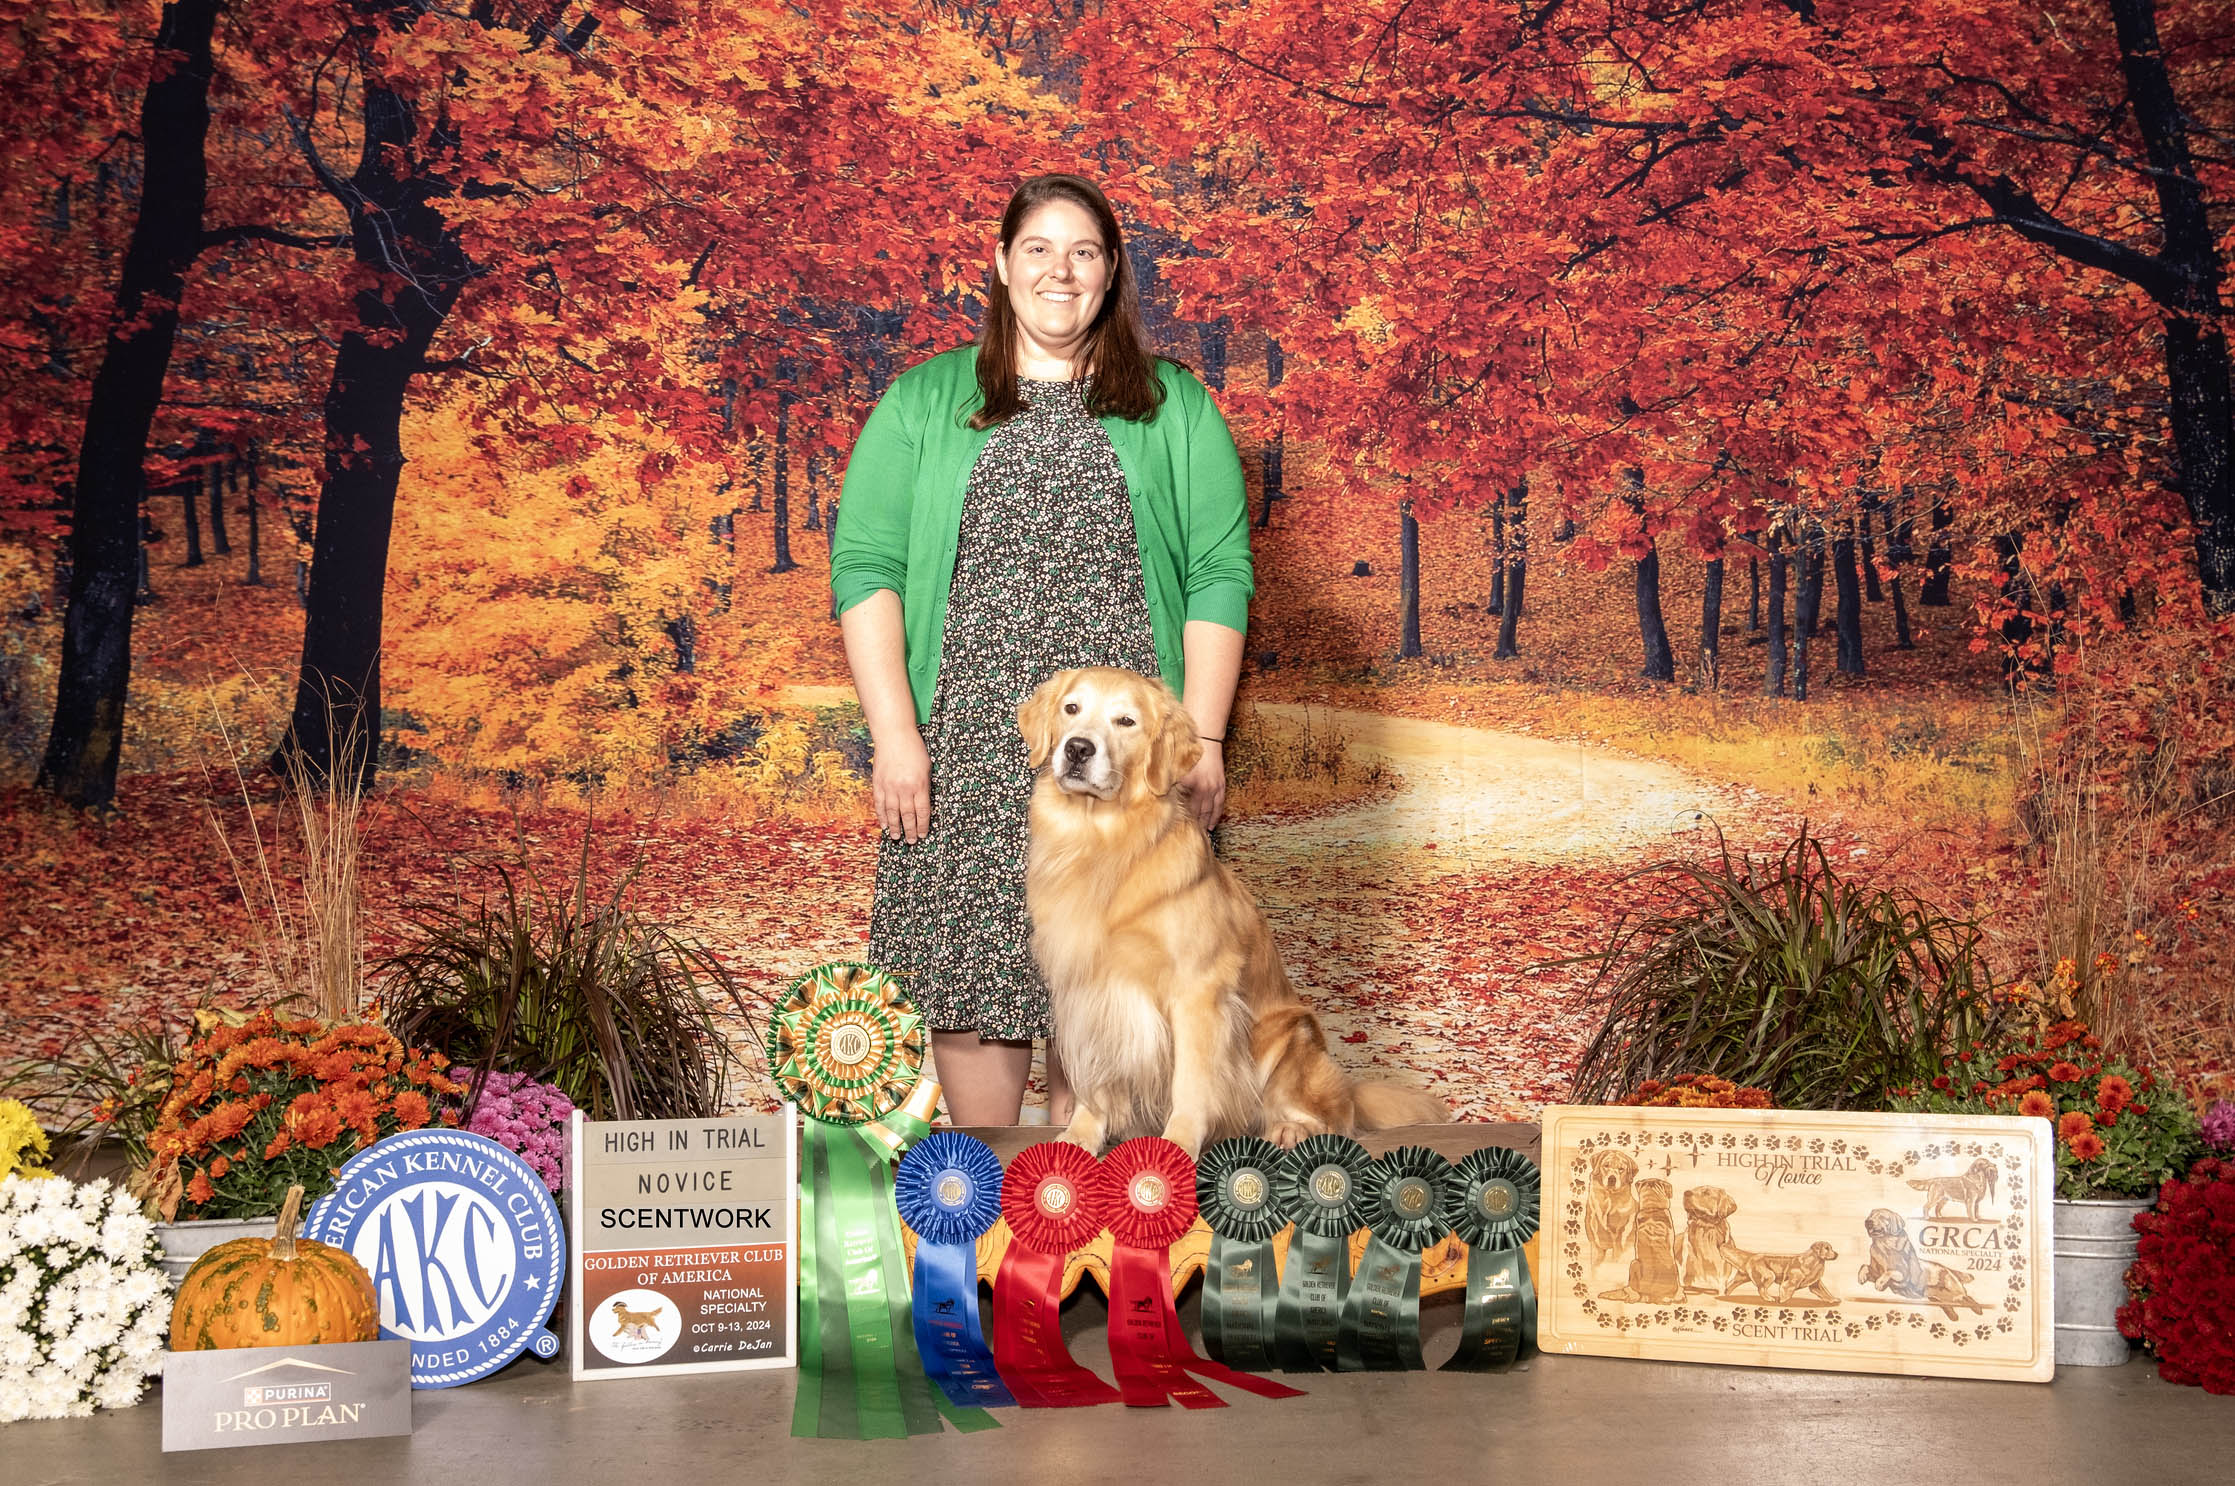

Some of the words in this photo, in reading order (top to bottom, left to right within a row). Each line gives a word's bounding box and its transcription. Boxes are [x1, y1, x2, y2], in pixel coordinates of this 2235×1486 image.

[605, 1130, 655, 1153] HIGH
[668, 1130, 688, 1151] IN
[703, 1127, 766, 1150] TRIAL
[1716, 1152, 1767, 1169] HIGH
[1773, 1154, 1794, 1169] IN
[1800, 1155, 1857, 1172] TRIAL
[638, 1170, 734, 1194] NOVICE
[1754, 1162, 1823, 1189] Novice
[324, 1161, 399, 1249] ERICAN
[402, 1151, 510, 1196] KENNEL
[506, 1192, 544, 1261] CLUB
[600, 1207, 772, 1230] SCENTWORK
[1919, 1225, 2002, 1250] GRCA
[373, 1188, 508, 1336] AKC
[584, 1256, 650, 1271] GOLDEN
[654, 1251, 740, 1268] RETRIEVER
[743, 1248, 784, 1263] CLUB
[1920, 1247, 1960, 1257] NATIONAL
[1967, 1257, 2001, 1272] 2024
[637, 1272, 659, 1286] OF
[661, 1269, 733, 1285] AMERICA
[703, 1288, 764, 1301] NATIONAL
[700, 1301, 767, 1315] SPECIALTY
[691, 1323, 715, 1334] OCT
[717, 1322, 743, 1333] 9-13,
[746, 1320, 771, 1331] 2024
[1732, 1323, 1788, 1340] SCENT
[1791, 1326, 1843, 1343] TRIAL
[411, 1349, 470, 1369] NDED
[478, 1316, 520, 1354] 1884
[738, 1339, 772, 1351] DeJan
[214, 1409, 276, 1433] PRO
